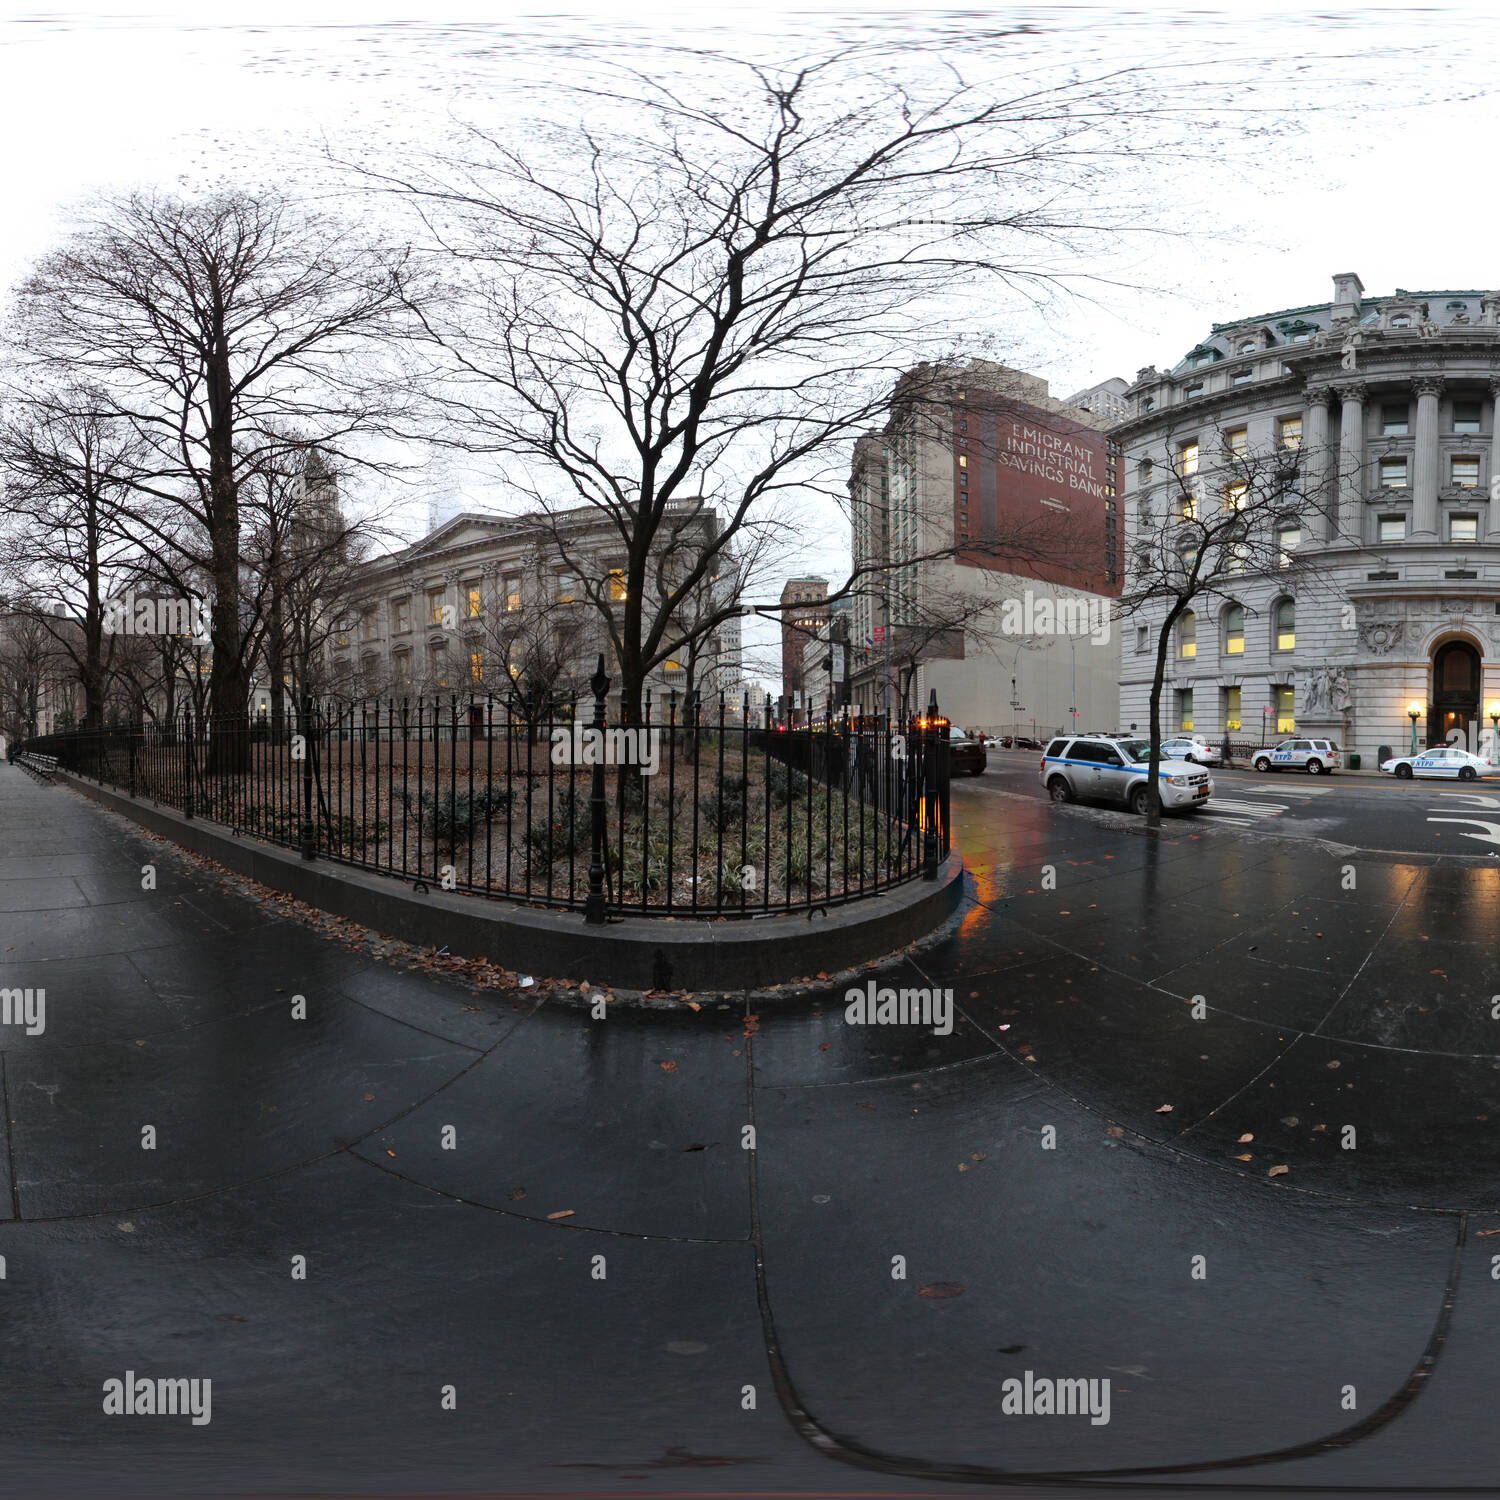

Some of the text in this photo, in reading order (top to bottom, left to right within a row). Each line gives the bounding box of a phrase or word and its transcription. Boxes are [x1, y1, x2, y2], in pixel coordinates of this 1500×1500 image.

[1007, 437, 1097, 481] INDUSTRIAL
[1013, 424, 1094, 463] EMIGRANT
[999, 452, 1104, 499] SAVINGS BANK
[1273, 752, 1293, 761] NYPD
